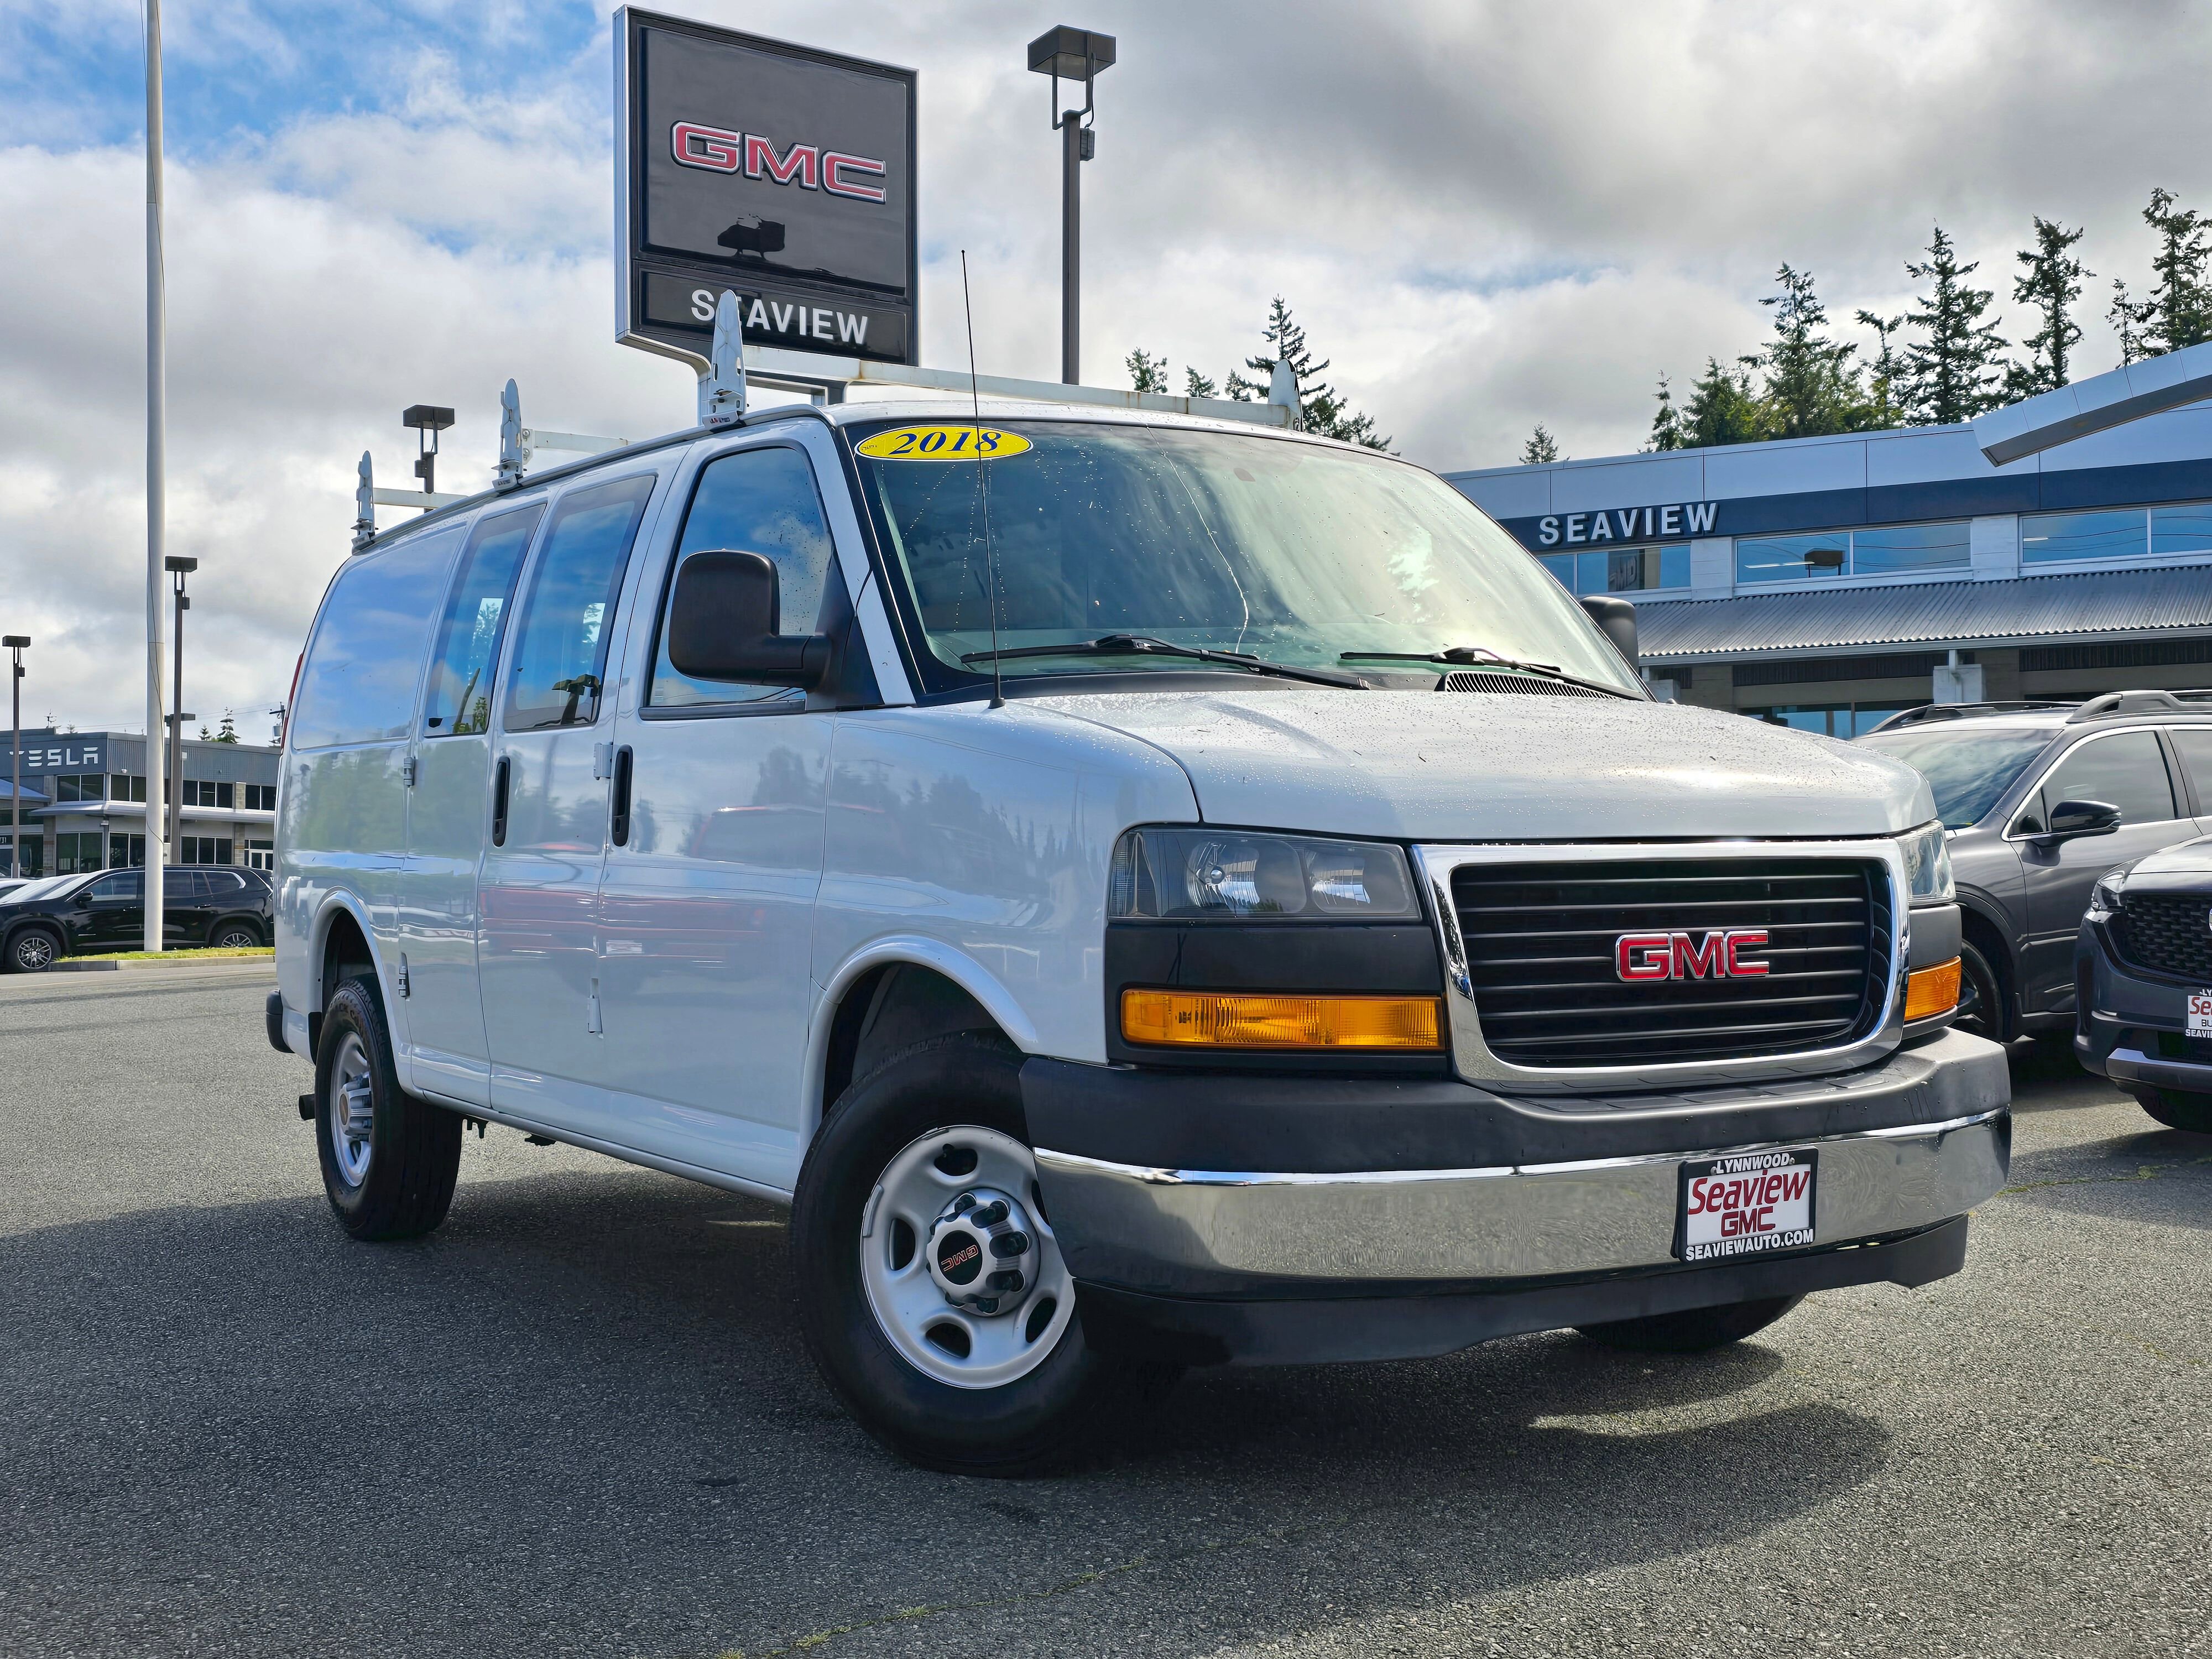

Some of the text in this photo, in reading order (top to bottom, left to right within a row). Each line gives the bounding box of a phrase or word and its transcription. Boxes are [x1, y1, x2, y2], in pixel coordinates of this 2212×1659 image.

[670, 121, 886, 204] GMC
[691, 289, 868, 345] SAVIEW
[888, 431, 1002, 455] 2018
[1539, 503, 1718, 545] SEAVIEW
[1615, 930, 1770, 982] GMC
[2189, 997, 2212, 1015] Se
[1716, 1153, 1790, 1174] LYNNWOOD
[1688, 1170, 1811, 1215] Seaview
[1721, 1206, 1776, 1237] GMC
[941, 1244, 979, 1271] GMC
[1686, 1229, 1813, 1261] SEAVIEWAUTO.COM
